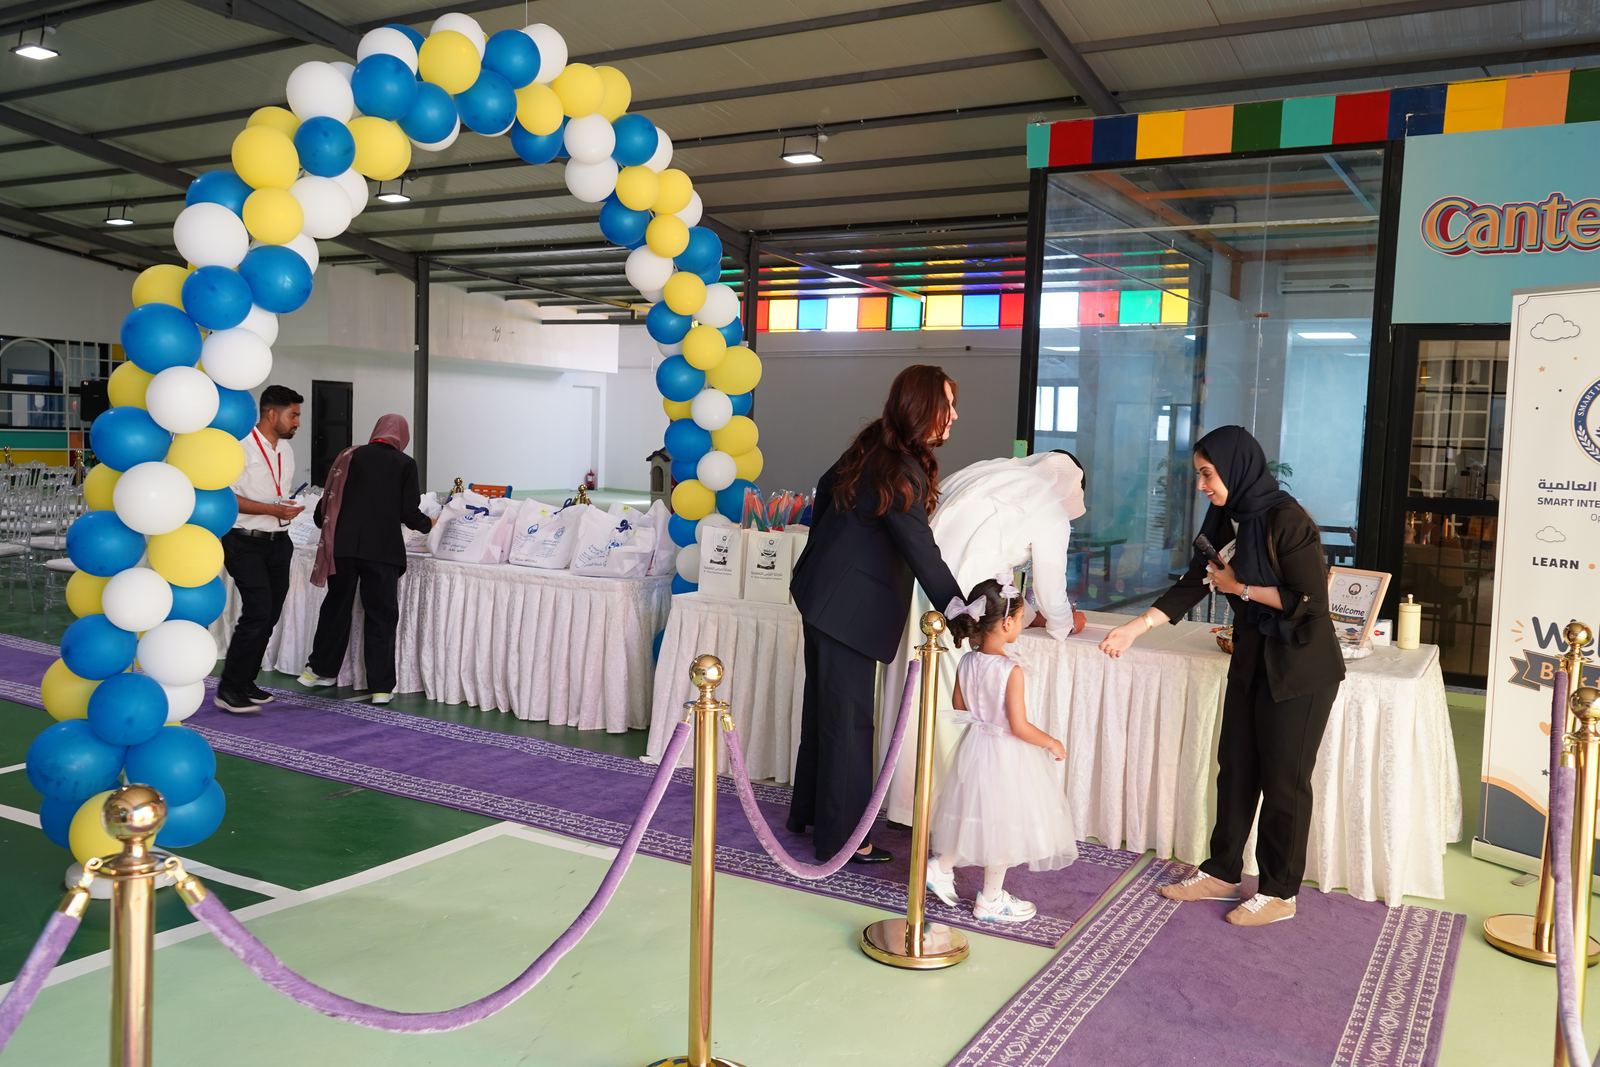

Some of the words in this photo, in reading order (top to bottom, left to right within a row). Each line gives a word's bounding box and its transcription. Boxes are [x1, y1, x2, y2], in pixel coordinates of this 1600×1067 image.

[1421, 191, 1600, 256] Cante
[1578, 389, 1596, 417] SMART
[1538, 478, 1597, 493] العالمية
[1537, 497, 1574, 507] SMART
[1577, 499, 1600, 508] INTE
[1532, 556, 1580, 570] LEARN
[1331, 603, 1365, 616] Welcome
